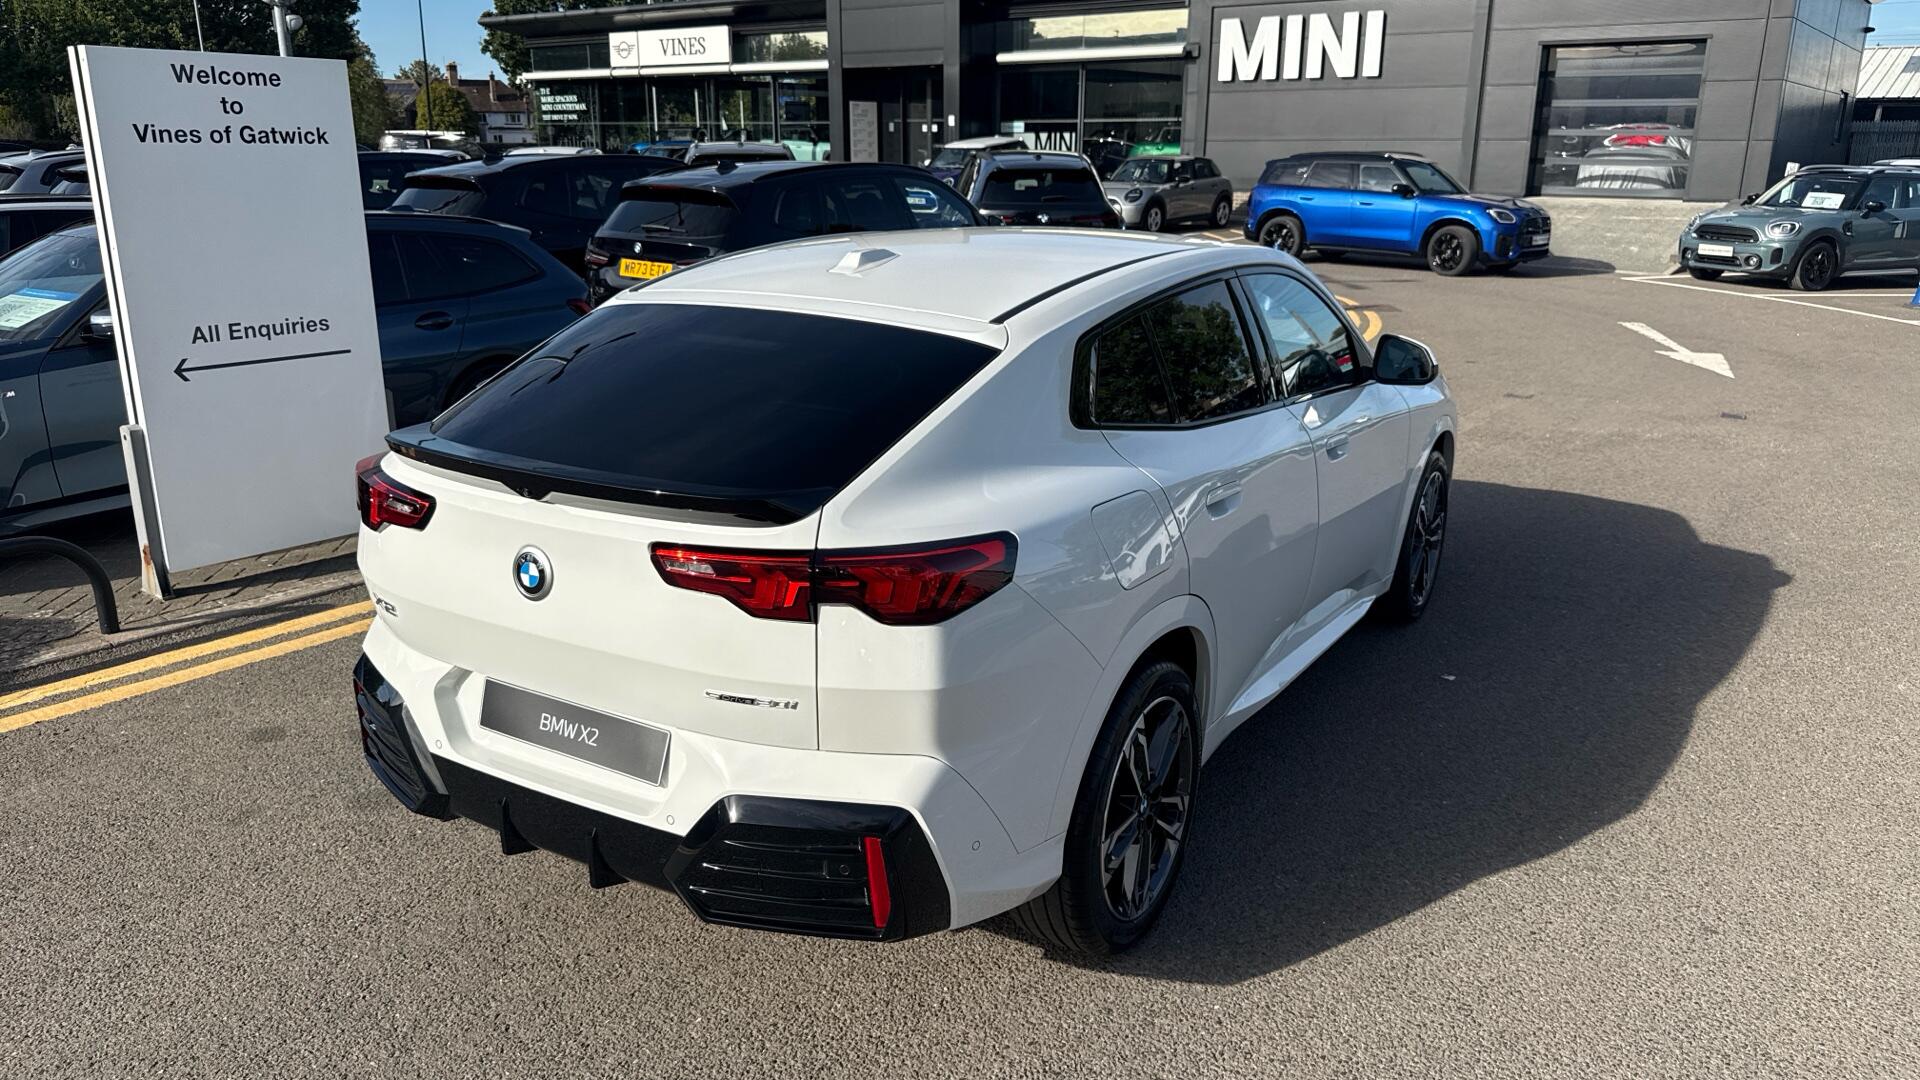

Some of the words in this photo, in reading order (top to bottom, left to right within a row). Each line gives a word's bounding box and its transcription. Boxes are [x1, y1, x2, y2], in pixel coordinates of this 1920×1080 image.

[659, 36, 706, 56] VINES
[1217, 9, 1385, 82] MINI
[170, 63, 282, 87] Welcome
[220, 96, 244, 115] to
[131, 123, 202, 144] Vines
[209, 125, 232, 144] of
[239, 125, 330, 145] Gatwick
[191, 324, 221, 345] All
[228, 316, 330, 341] Enquiries
[539, 712, 578, 739] BMW
[578, 724, 599, 747] X2
